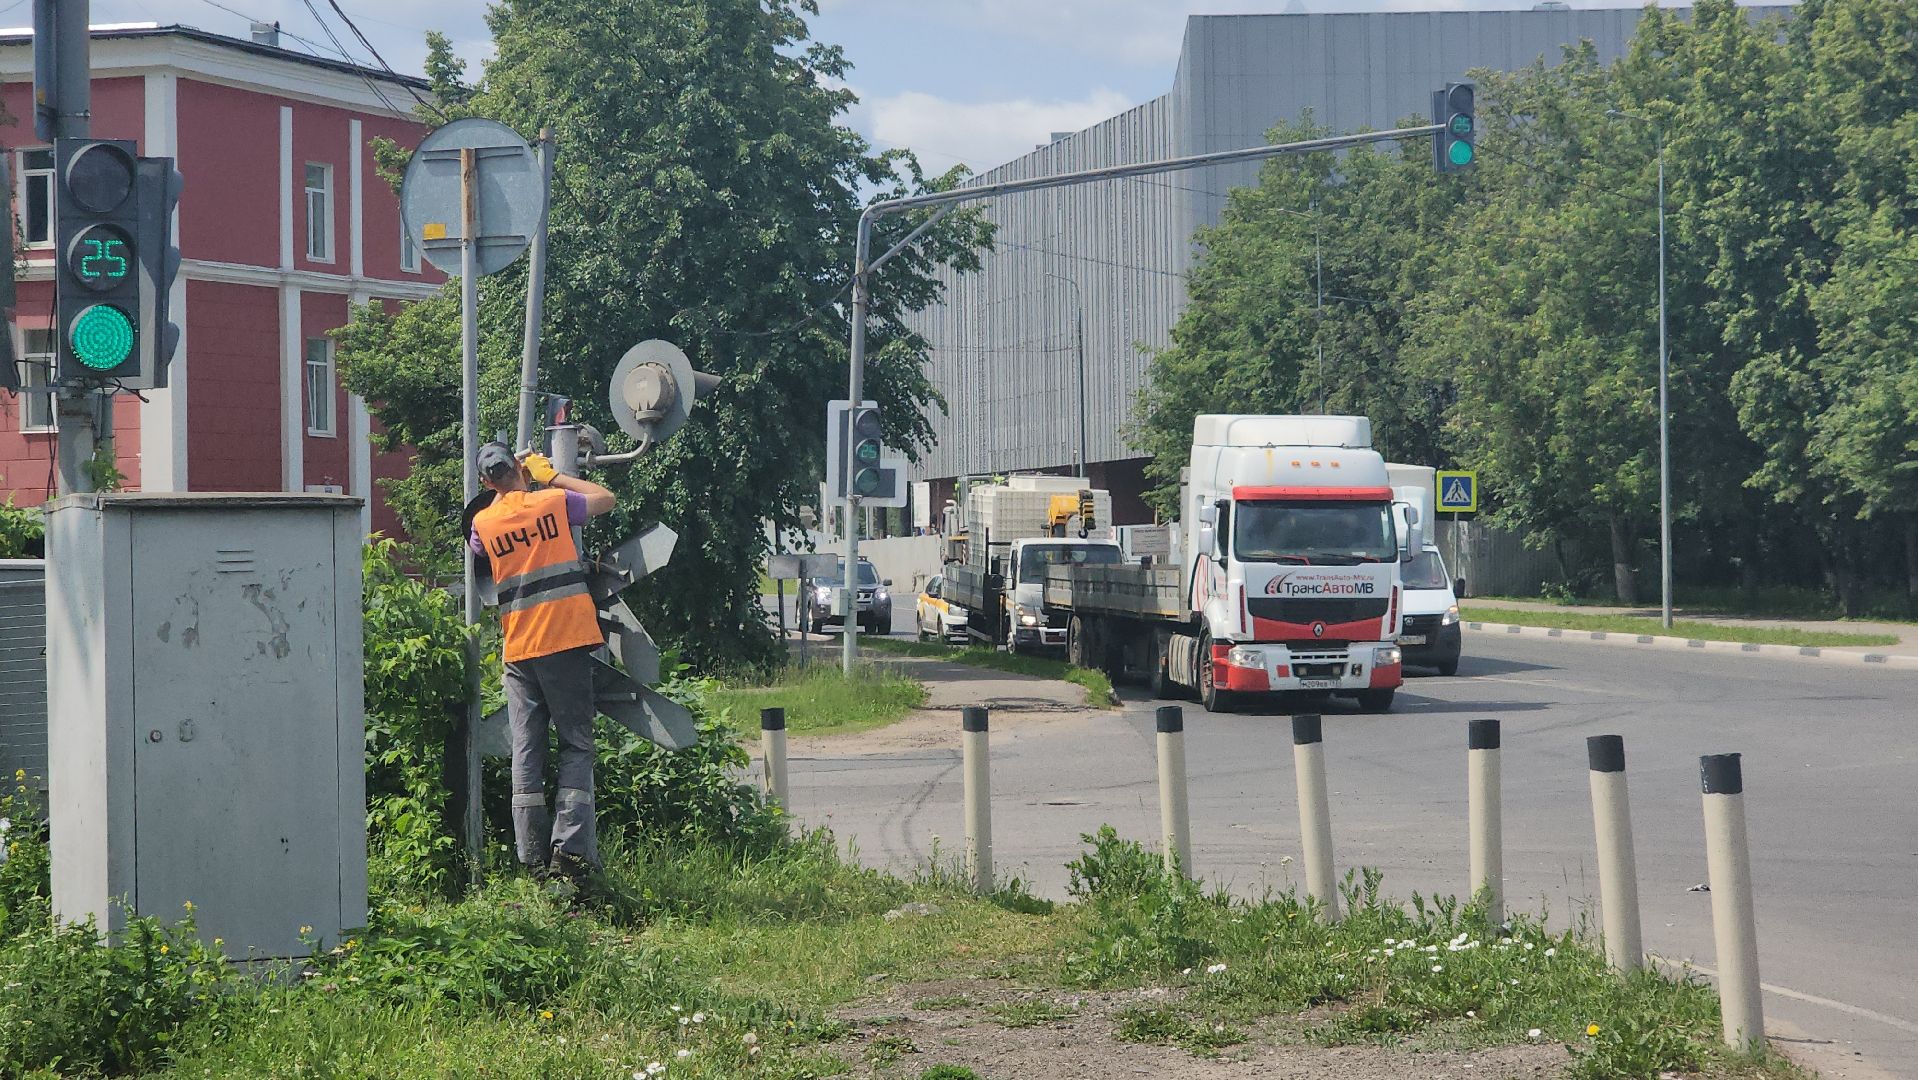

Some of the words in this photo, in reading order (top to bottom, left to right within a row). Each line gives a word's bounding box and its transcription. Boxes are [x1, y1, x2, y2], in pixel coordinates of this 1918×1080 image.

[82, 239, 126, 277] 25
[861, 444, 877, 459] 25
[490, 512, 559, 558] ШЧ-10
[1284, 582, 1375, 597] ТрансАвтоМВ
